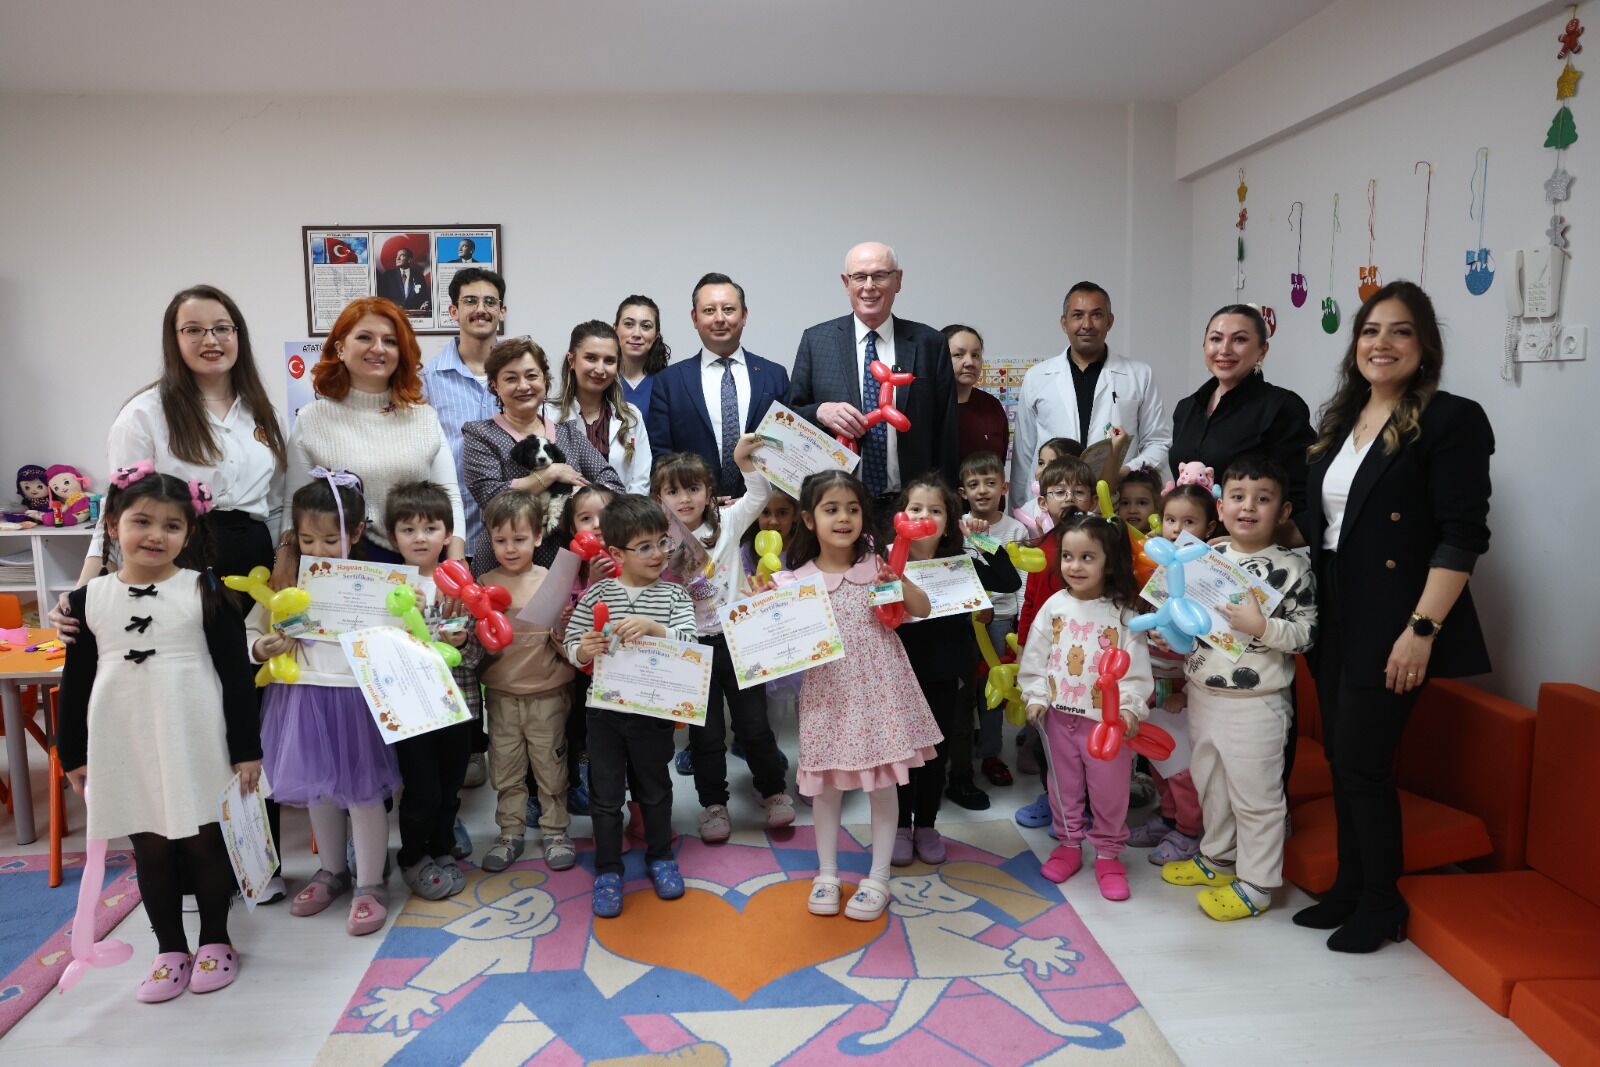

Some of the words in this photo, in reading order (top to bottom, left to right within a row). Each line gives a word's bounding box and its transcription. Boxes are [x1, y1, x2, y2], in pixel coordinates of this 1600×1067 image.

[302, 343, 323, 352] ATATÜ
[1208, 553, 1232, 571] Hayvan
[336, 564, 362, 573] Hayvan
